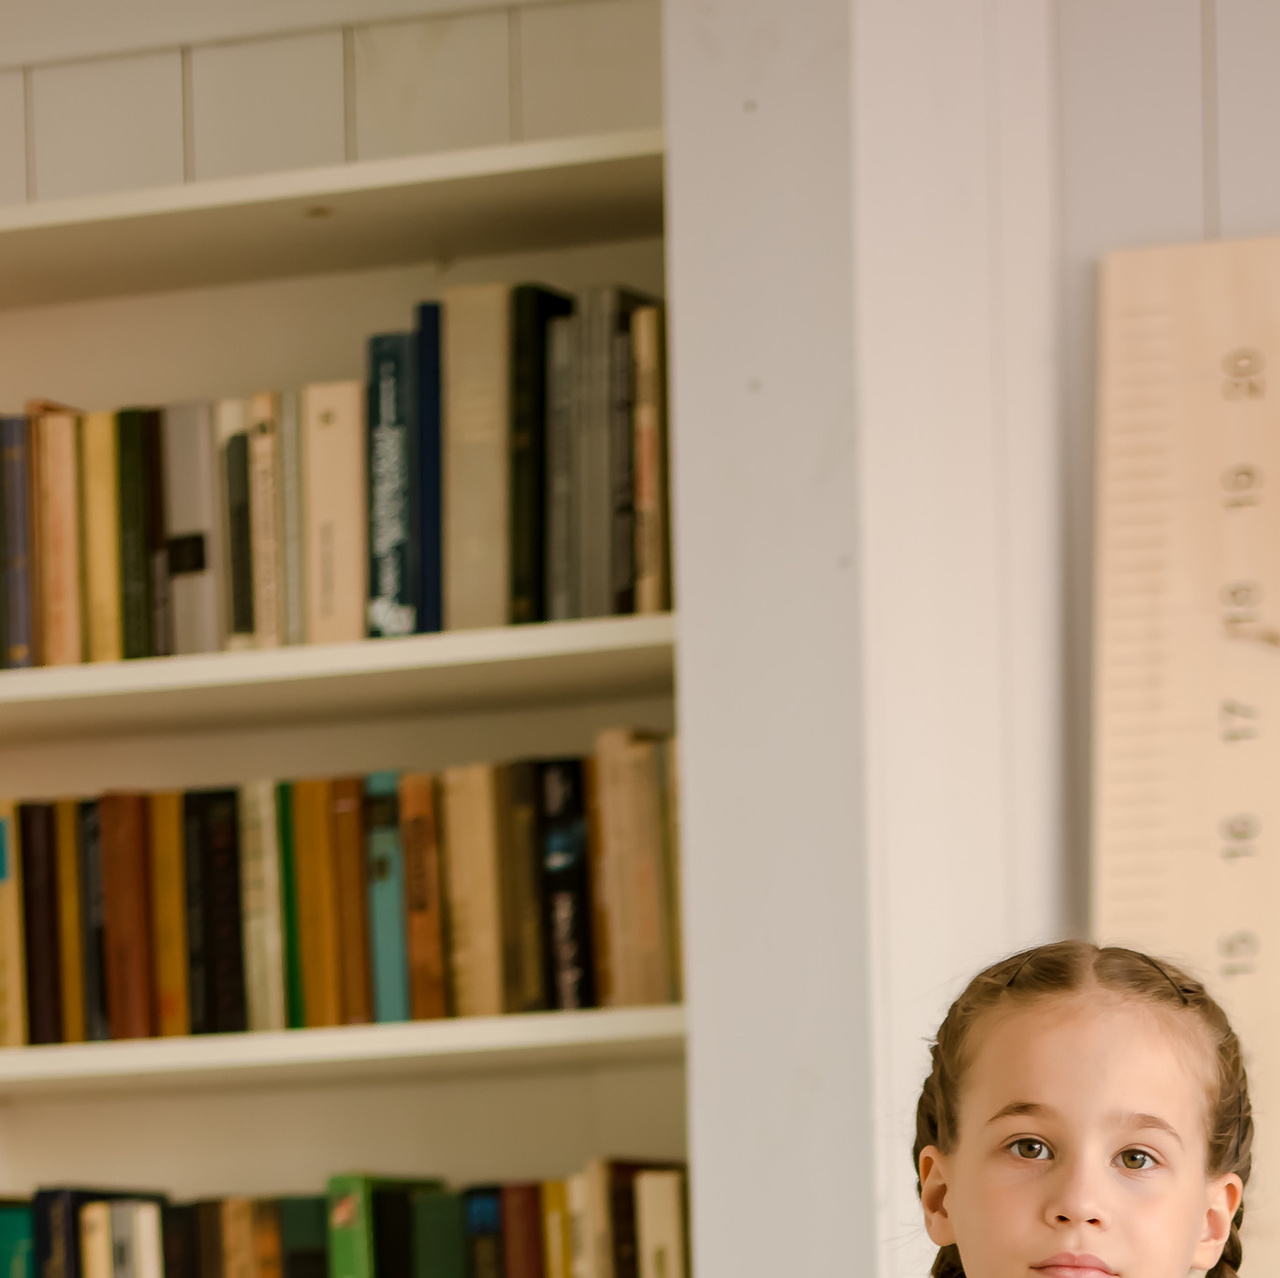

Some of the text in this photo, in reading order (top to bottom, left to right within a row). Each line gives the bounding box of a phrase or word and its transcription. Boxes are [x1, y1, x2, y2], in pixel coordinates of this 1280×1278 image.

[1220, 346, 1267, 402] 20
[1219, 463, 1266, 509] 19
[1218, 579, 1265, 627] 18
[1218, 699, 1260, 745] 17
[1218, 811, 1263, 861] 16
[1218, 929, 1263, 978] 15
